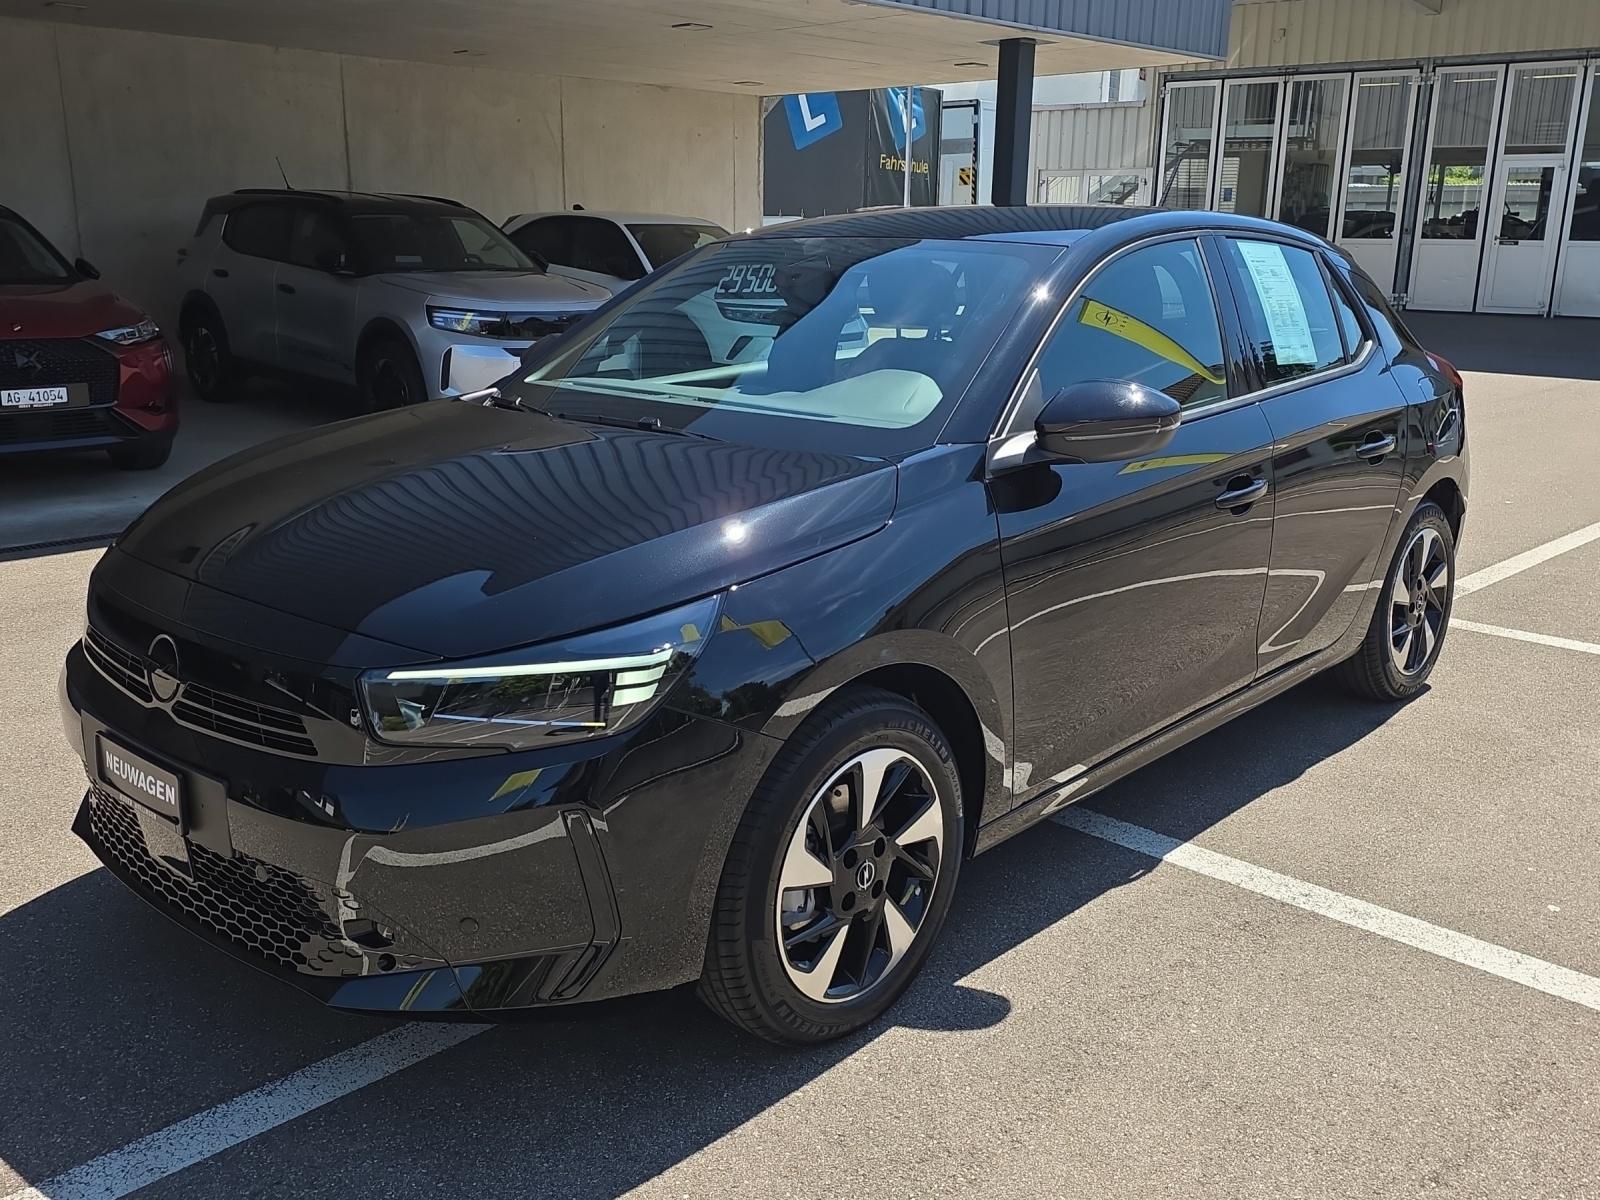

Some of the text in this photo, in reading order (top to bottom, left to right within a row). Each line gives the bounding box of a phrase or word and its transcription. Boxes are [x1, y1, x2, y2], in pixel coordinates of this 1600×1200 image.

[797, 94, 827, 132] L
[879, 153, 929, 174] Fahrshule
[7, 389, 64, 404] AG 41054
[886, 720, 949, 761] MICHELIN
[105, 751, 175, 805] NEUWAGEN
